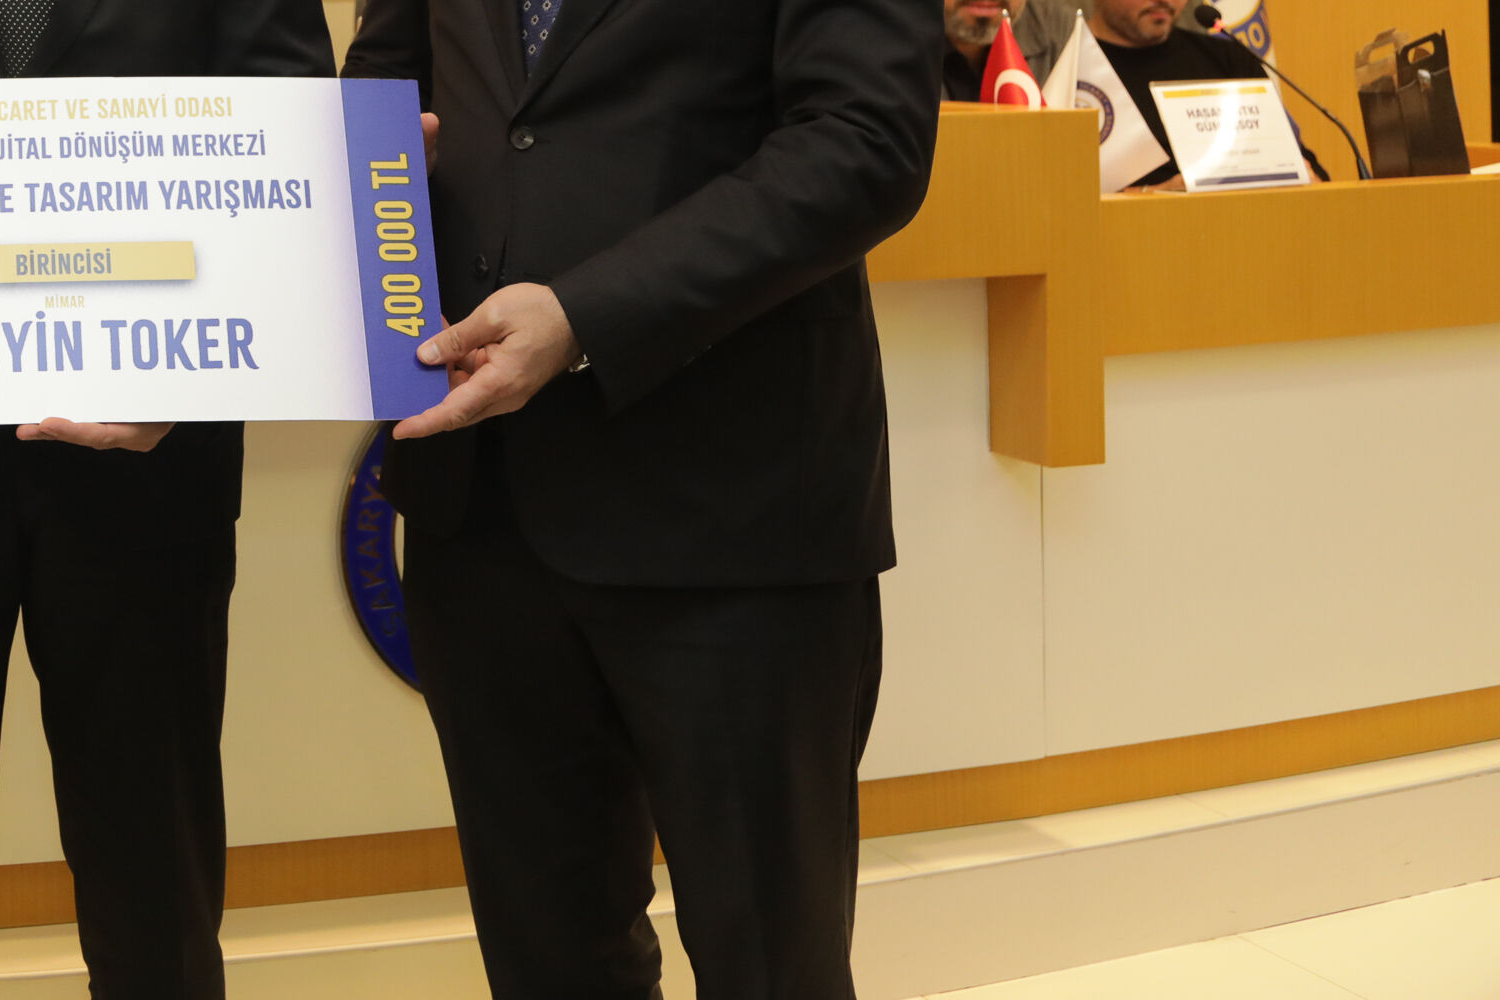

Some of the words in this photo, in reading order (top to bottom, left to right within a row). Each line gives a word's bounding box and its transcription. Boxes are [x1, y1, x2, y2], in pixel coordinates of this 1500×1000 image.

[65, 98, 90, 119] VE
[97, 93, 168, 119] SANAYİ
[174, 96, 233, 118] ODASI
[59, 130, 164, 164] DÖNÜŞÜM
[172, 129, 266, 157] MERKEZİ
[369, 152, 411, 191] TL
[24, 180, 149, 213] TASARIM
[157, 178, 312, 218] YARIŞMASI
[373, 199, 418, 263] 000
[15, 247, 113, 276] BİRİNCİSİ
[44, 294, 85, 309] MİMAR
[381, 273, 426, 338] 400
[100, 317, 260, 372] TOKER
